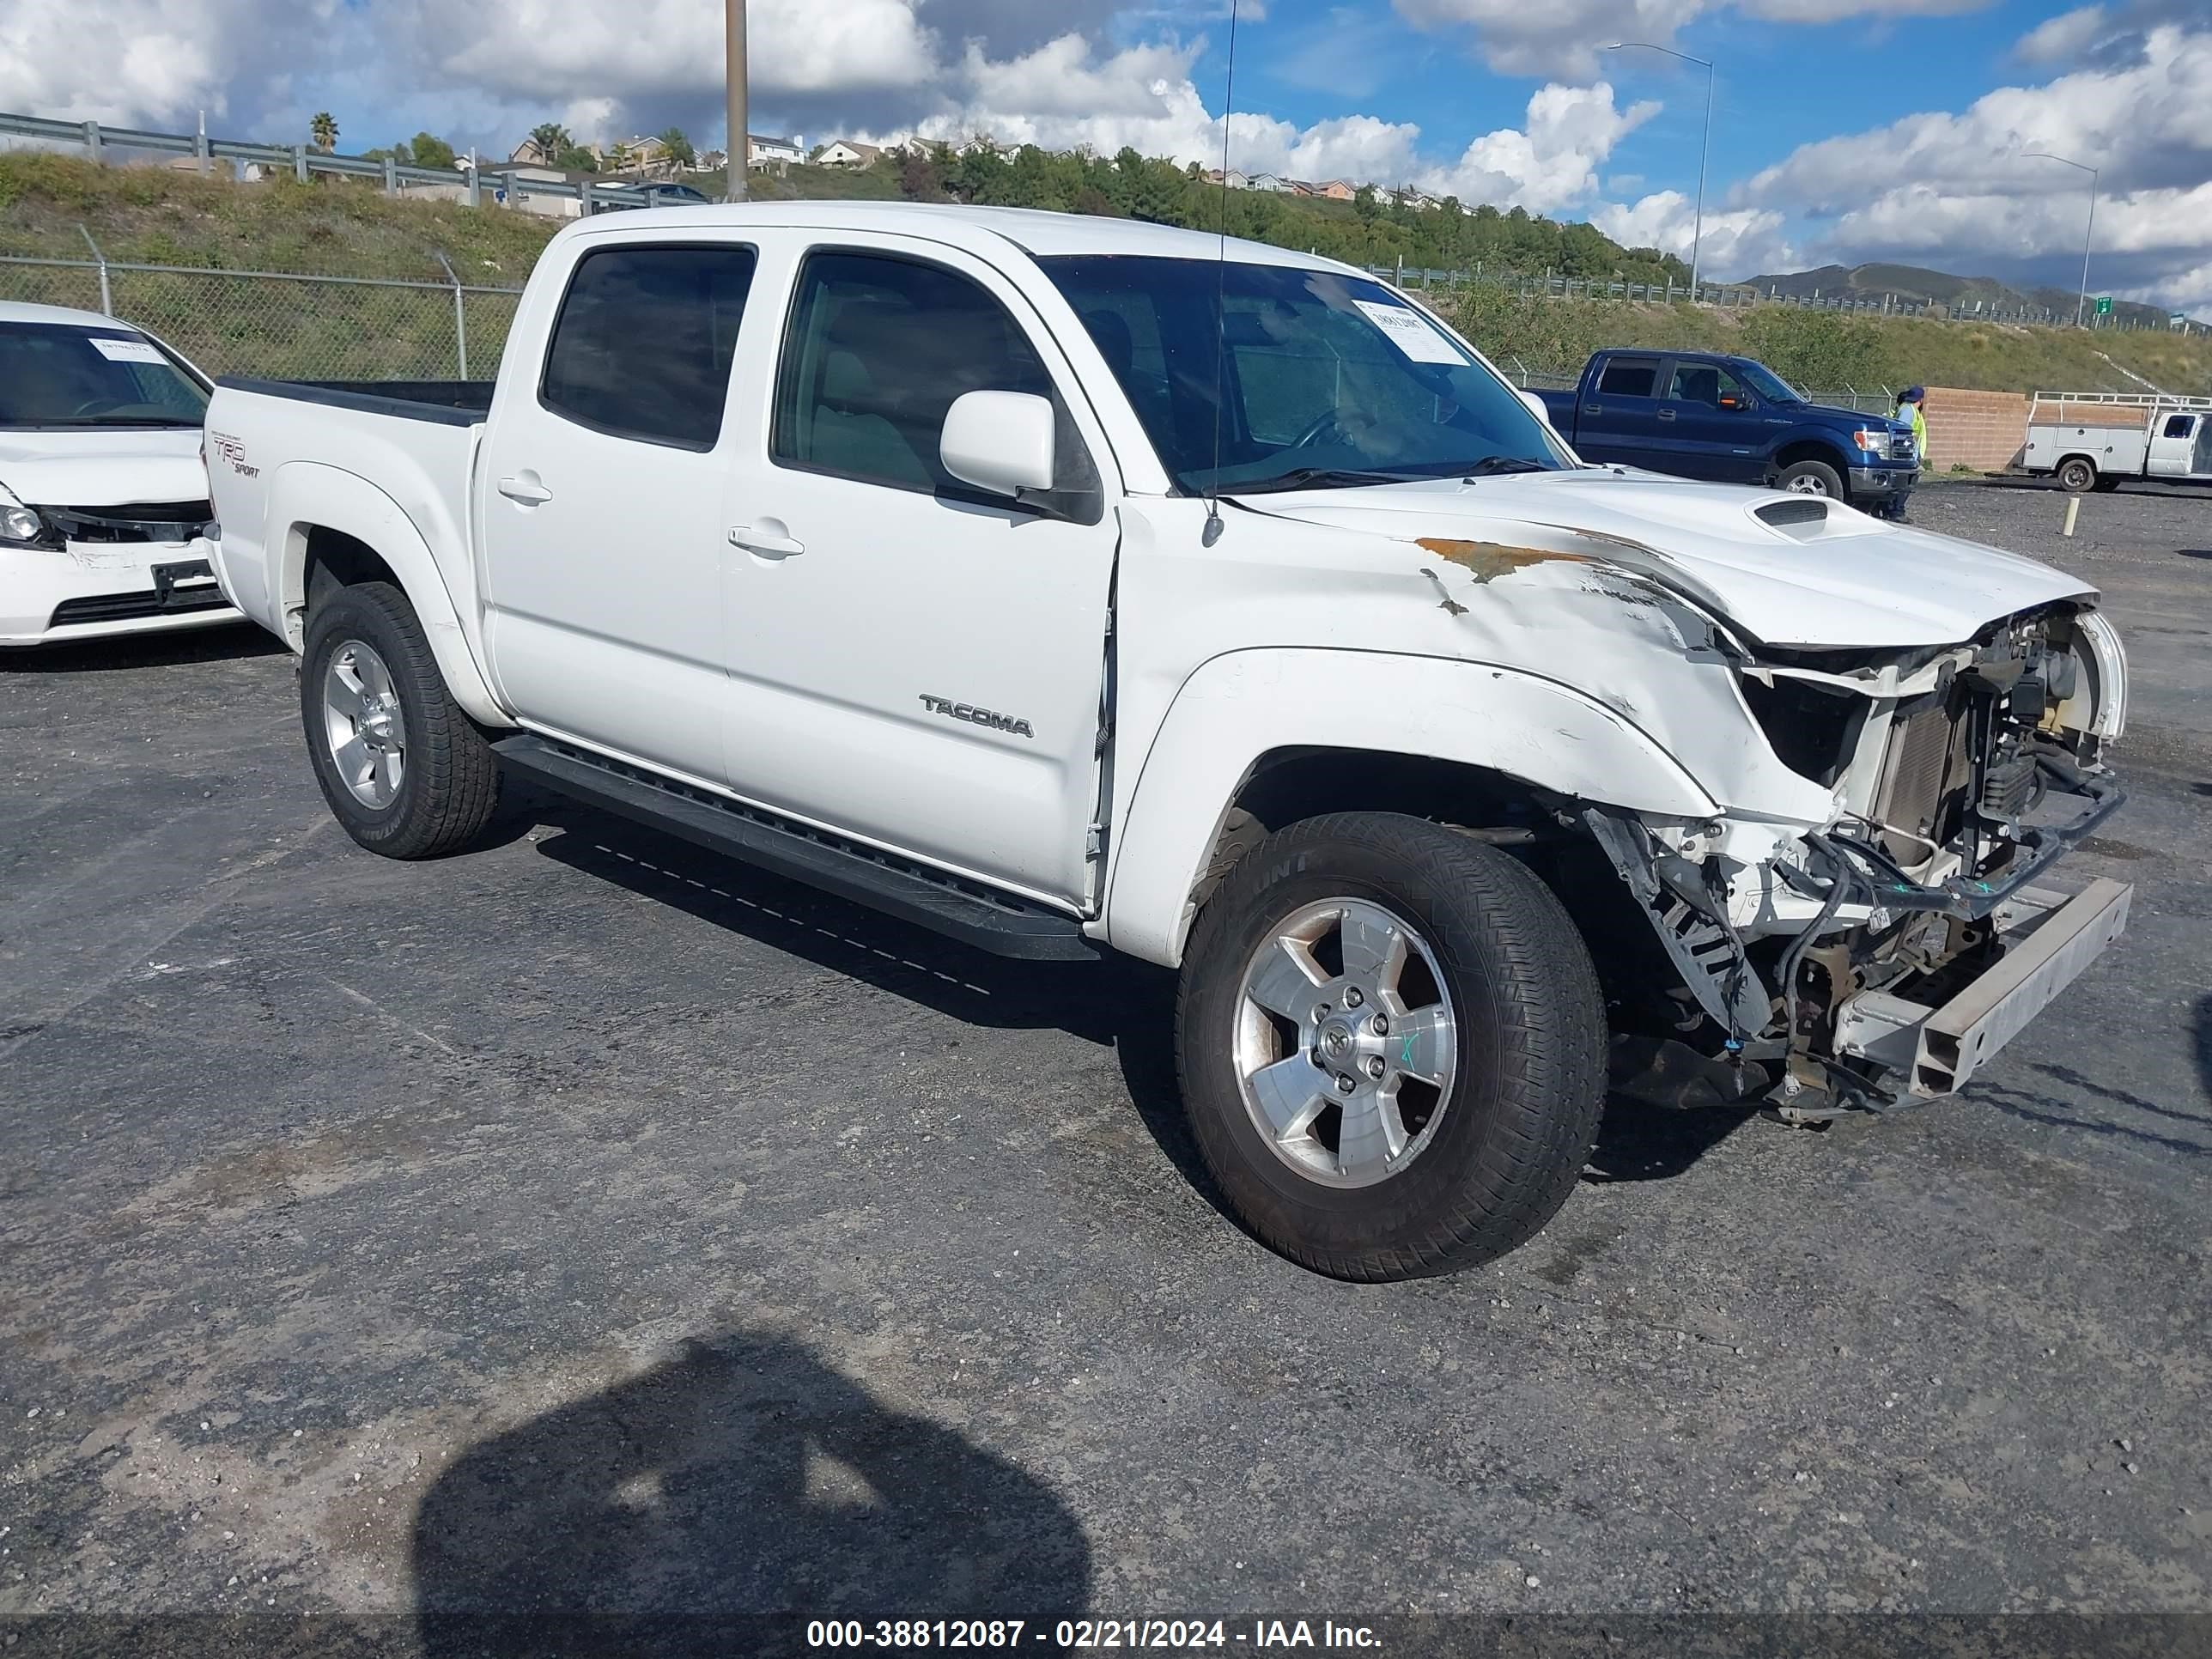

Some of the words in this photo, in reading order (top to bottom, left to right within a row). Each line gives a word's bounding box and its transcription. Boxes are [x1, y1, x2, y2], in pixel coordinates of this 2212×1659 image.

[214, 436, 246, 465] TRD
[234, 463, 261, 479] SPORT
[919, 693, 1035, 738] TACOMA
